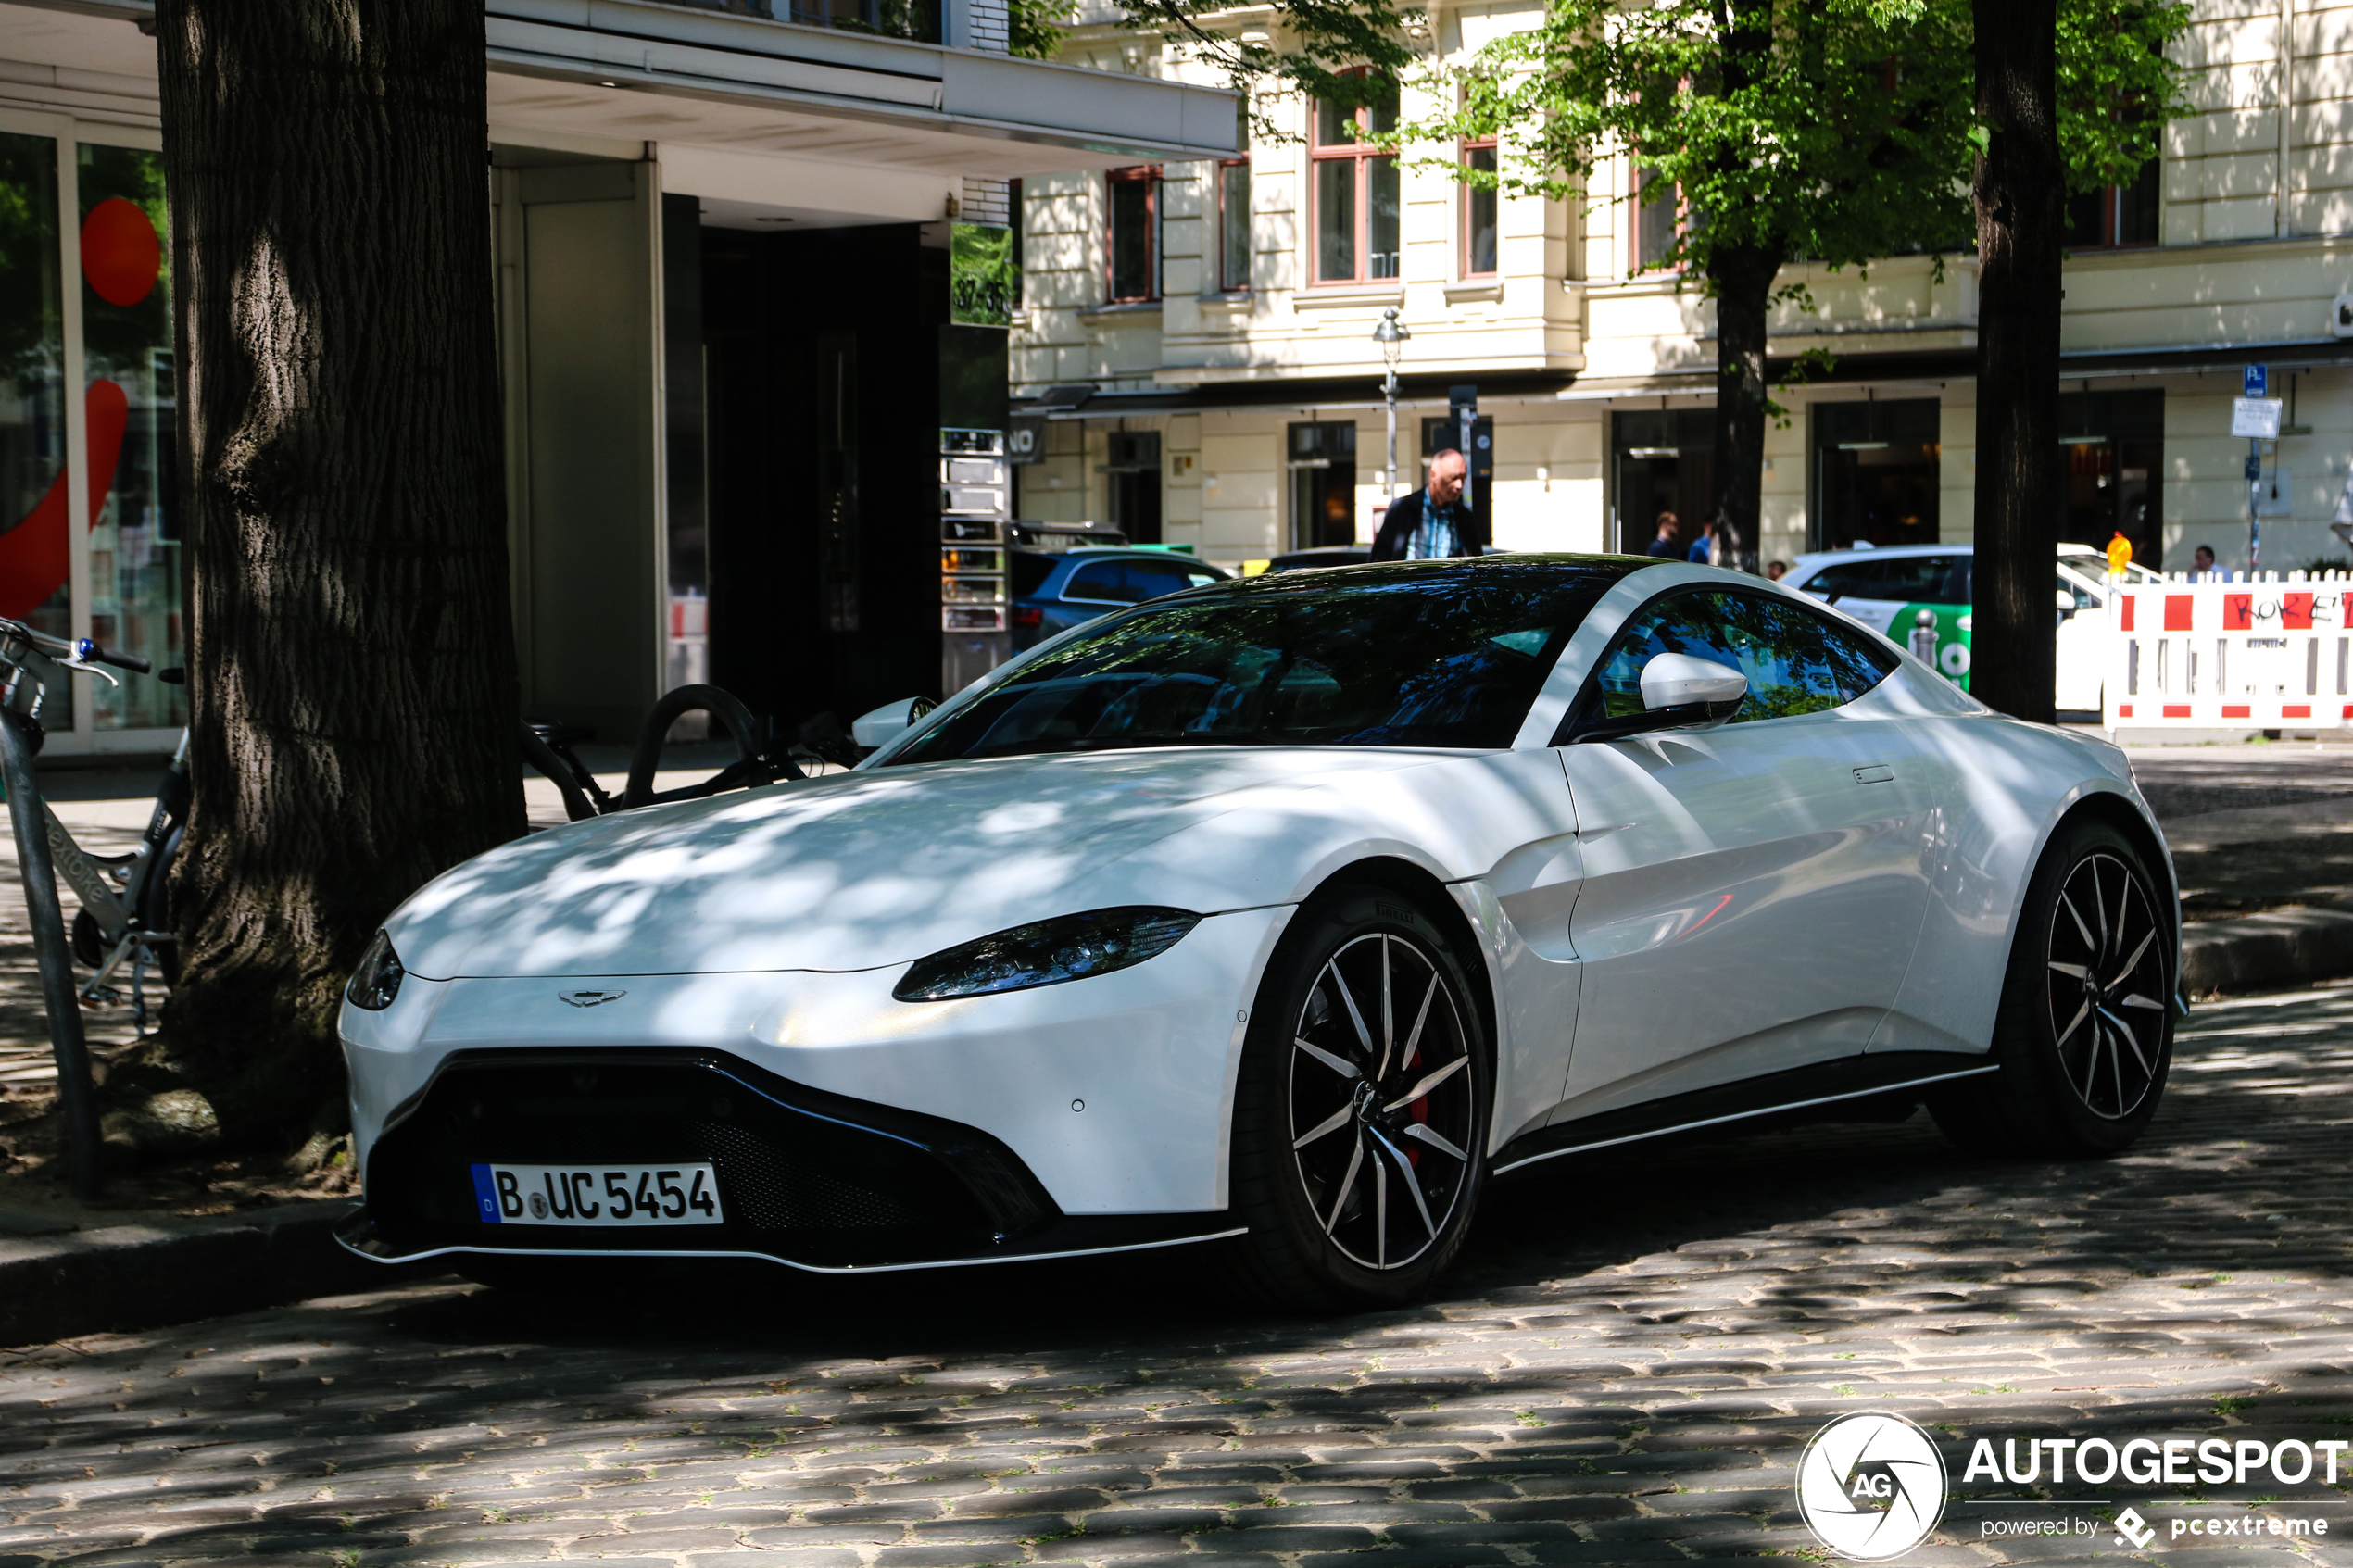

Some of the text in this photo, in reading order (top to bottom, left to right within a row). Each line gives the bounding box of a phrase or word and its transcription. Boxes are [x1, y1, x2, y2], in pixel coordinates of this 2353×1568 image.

[1375, 901, 1414, 924] PIRELLI
[484, 1198, 493, 1212] D
[496, 1170, 714, 1219] B UC 5454
